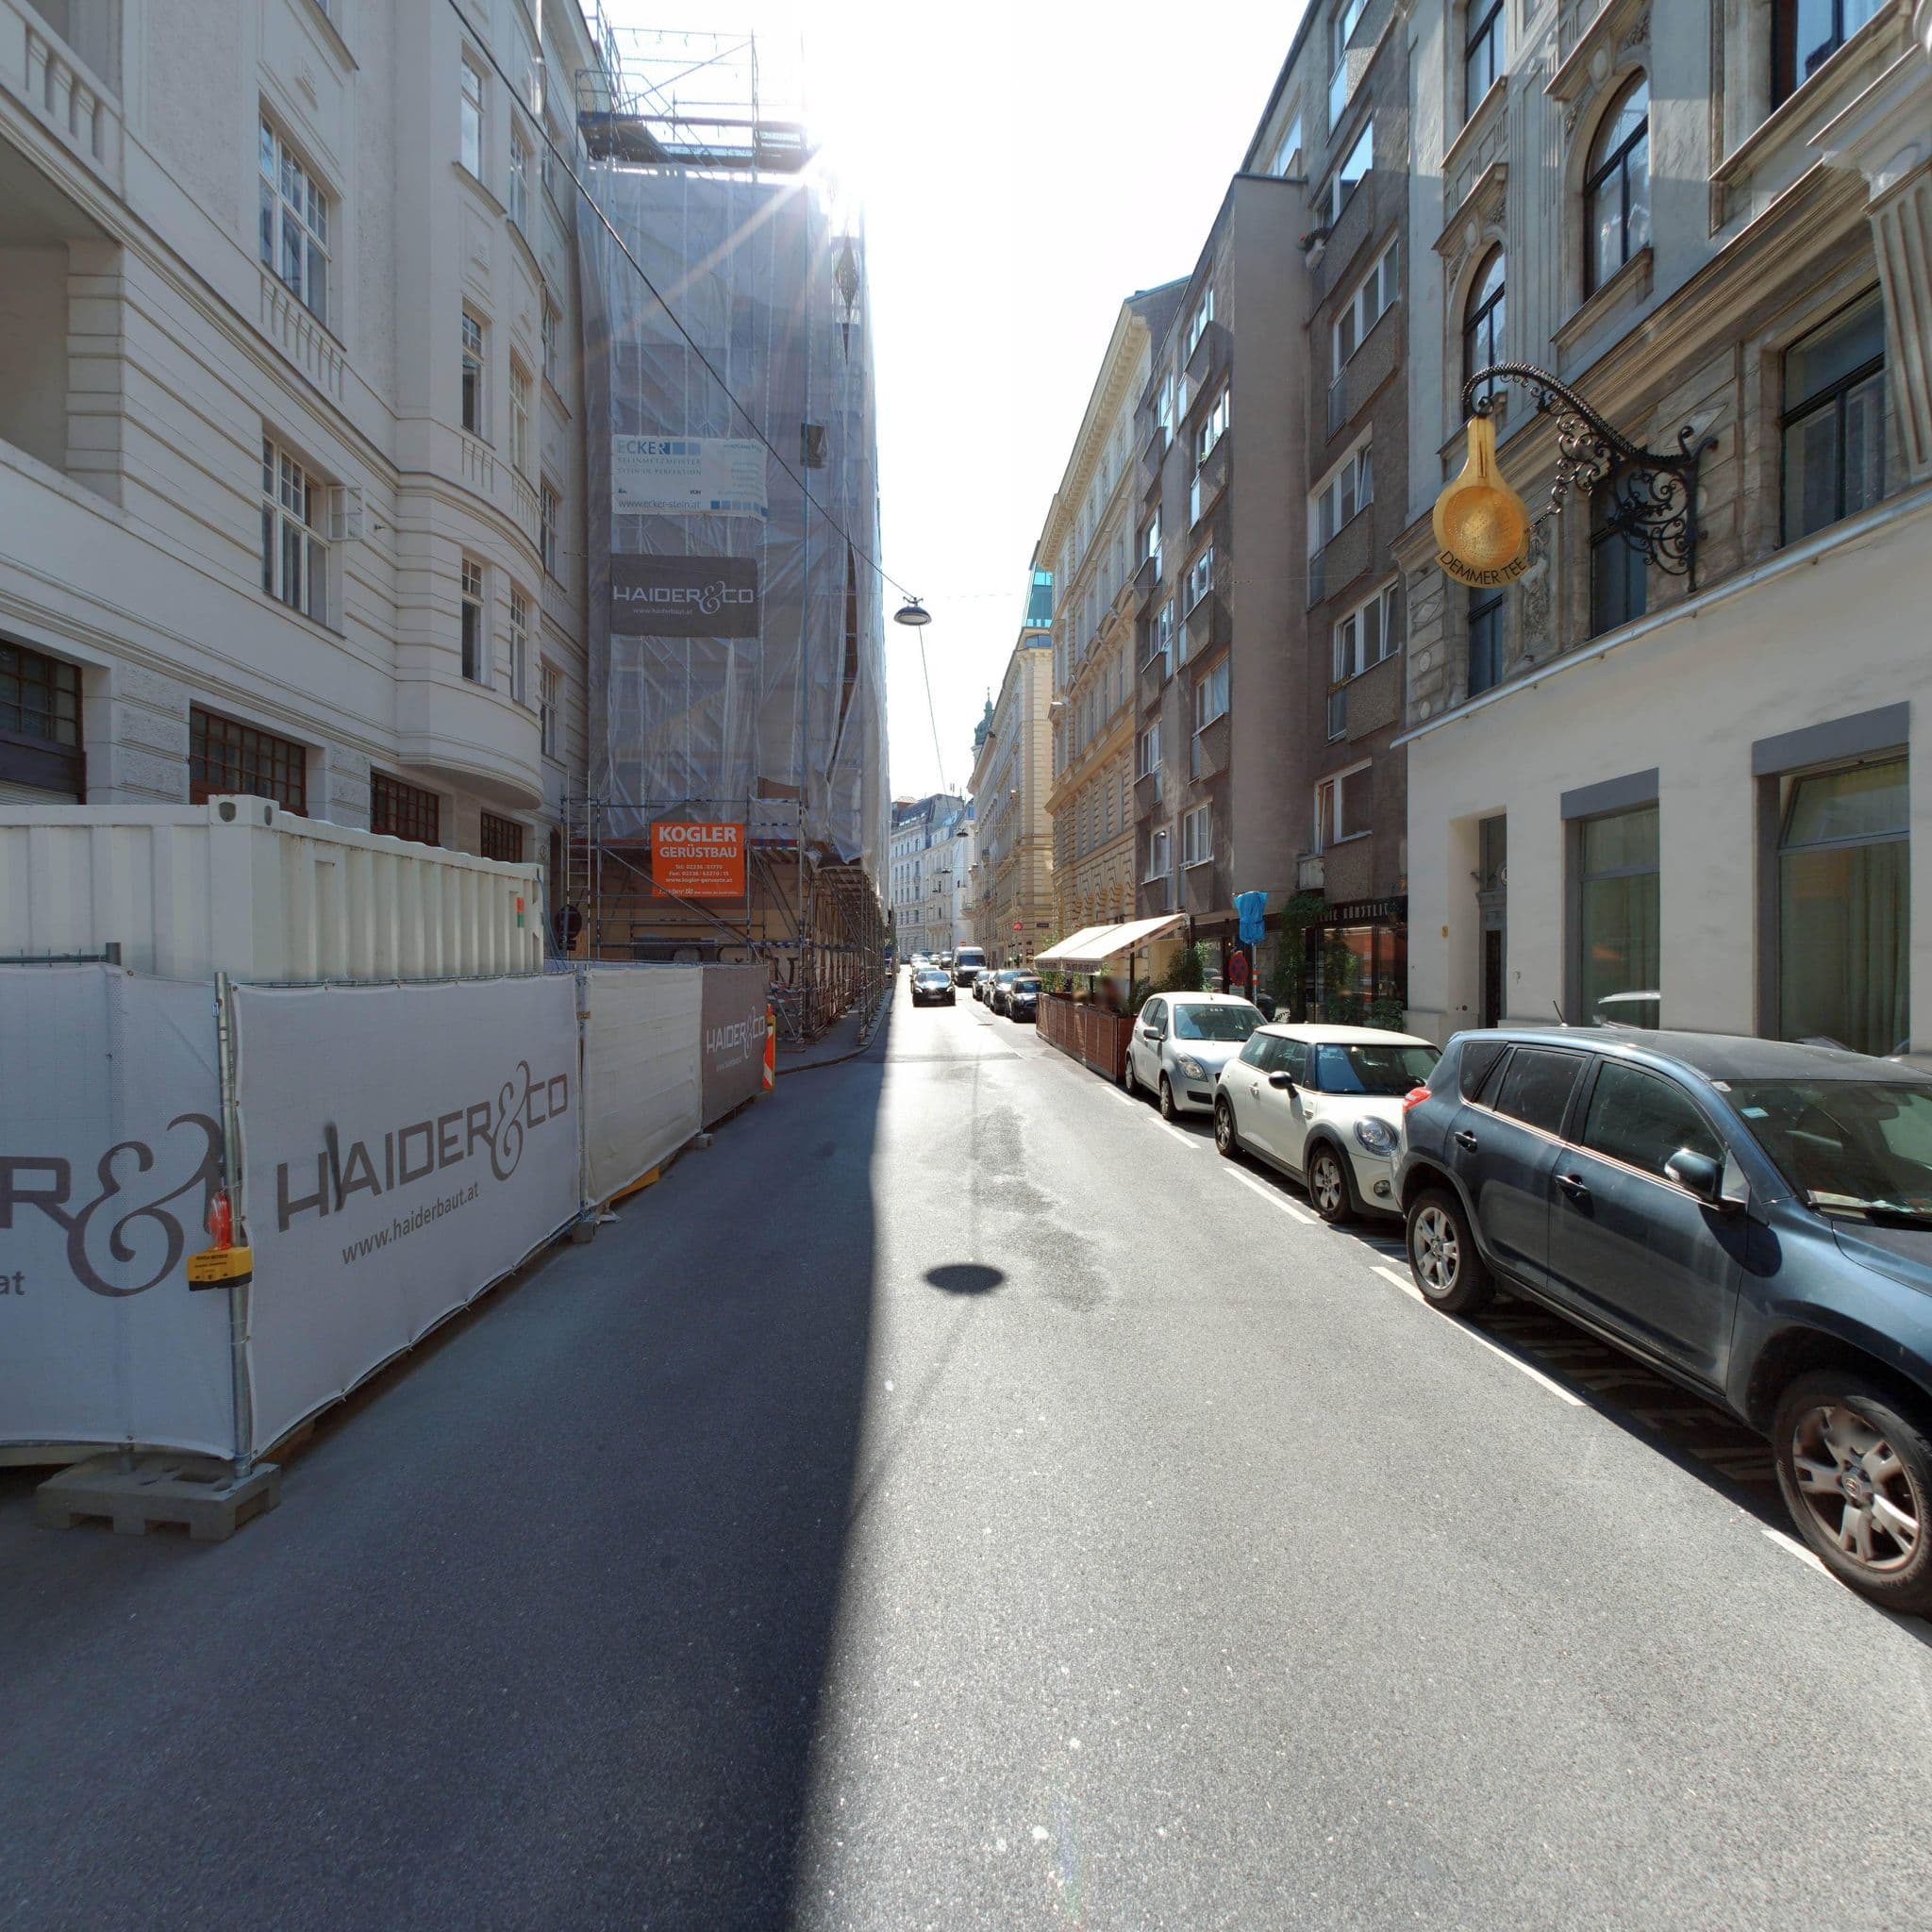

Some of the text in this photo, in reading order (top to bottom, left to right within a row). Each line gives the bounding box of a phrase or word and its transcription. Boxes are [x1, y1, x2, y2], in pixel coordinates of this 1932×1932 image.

[618, 441, 671, 455] ECKER
[1440, 551, 1526, 585] DEMMER TEE
[613, 581, 754, 614] HAIDER&CO
[658, 826, 737, 842] KOGLER
[659, 843, 737, 858] GERÜSTBAU
[706, 1006, 765, 1058] HAIDER&CO
[276, 1059, 568, 1233] HAIDER&CO
[341, 1181, 479, 1265] www.haiderbaut.at
